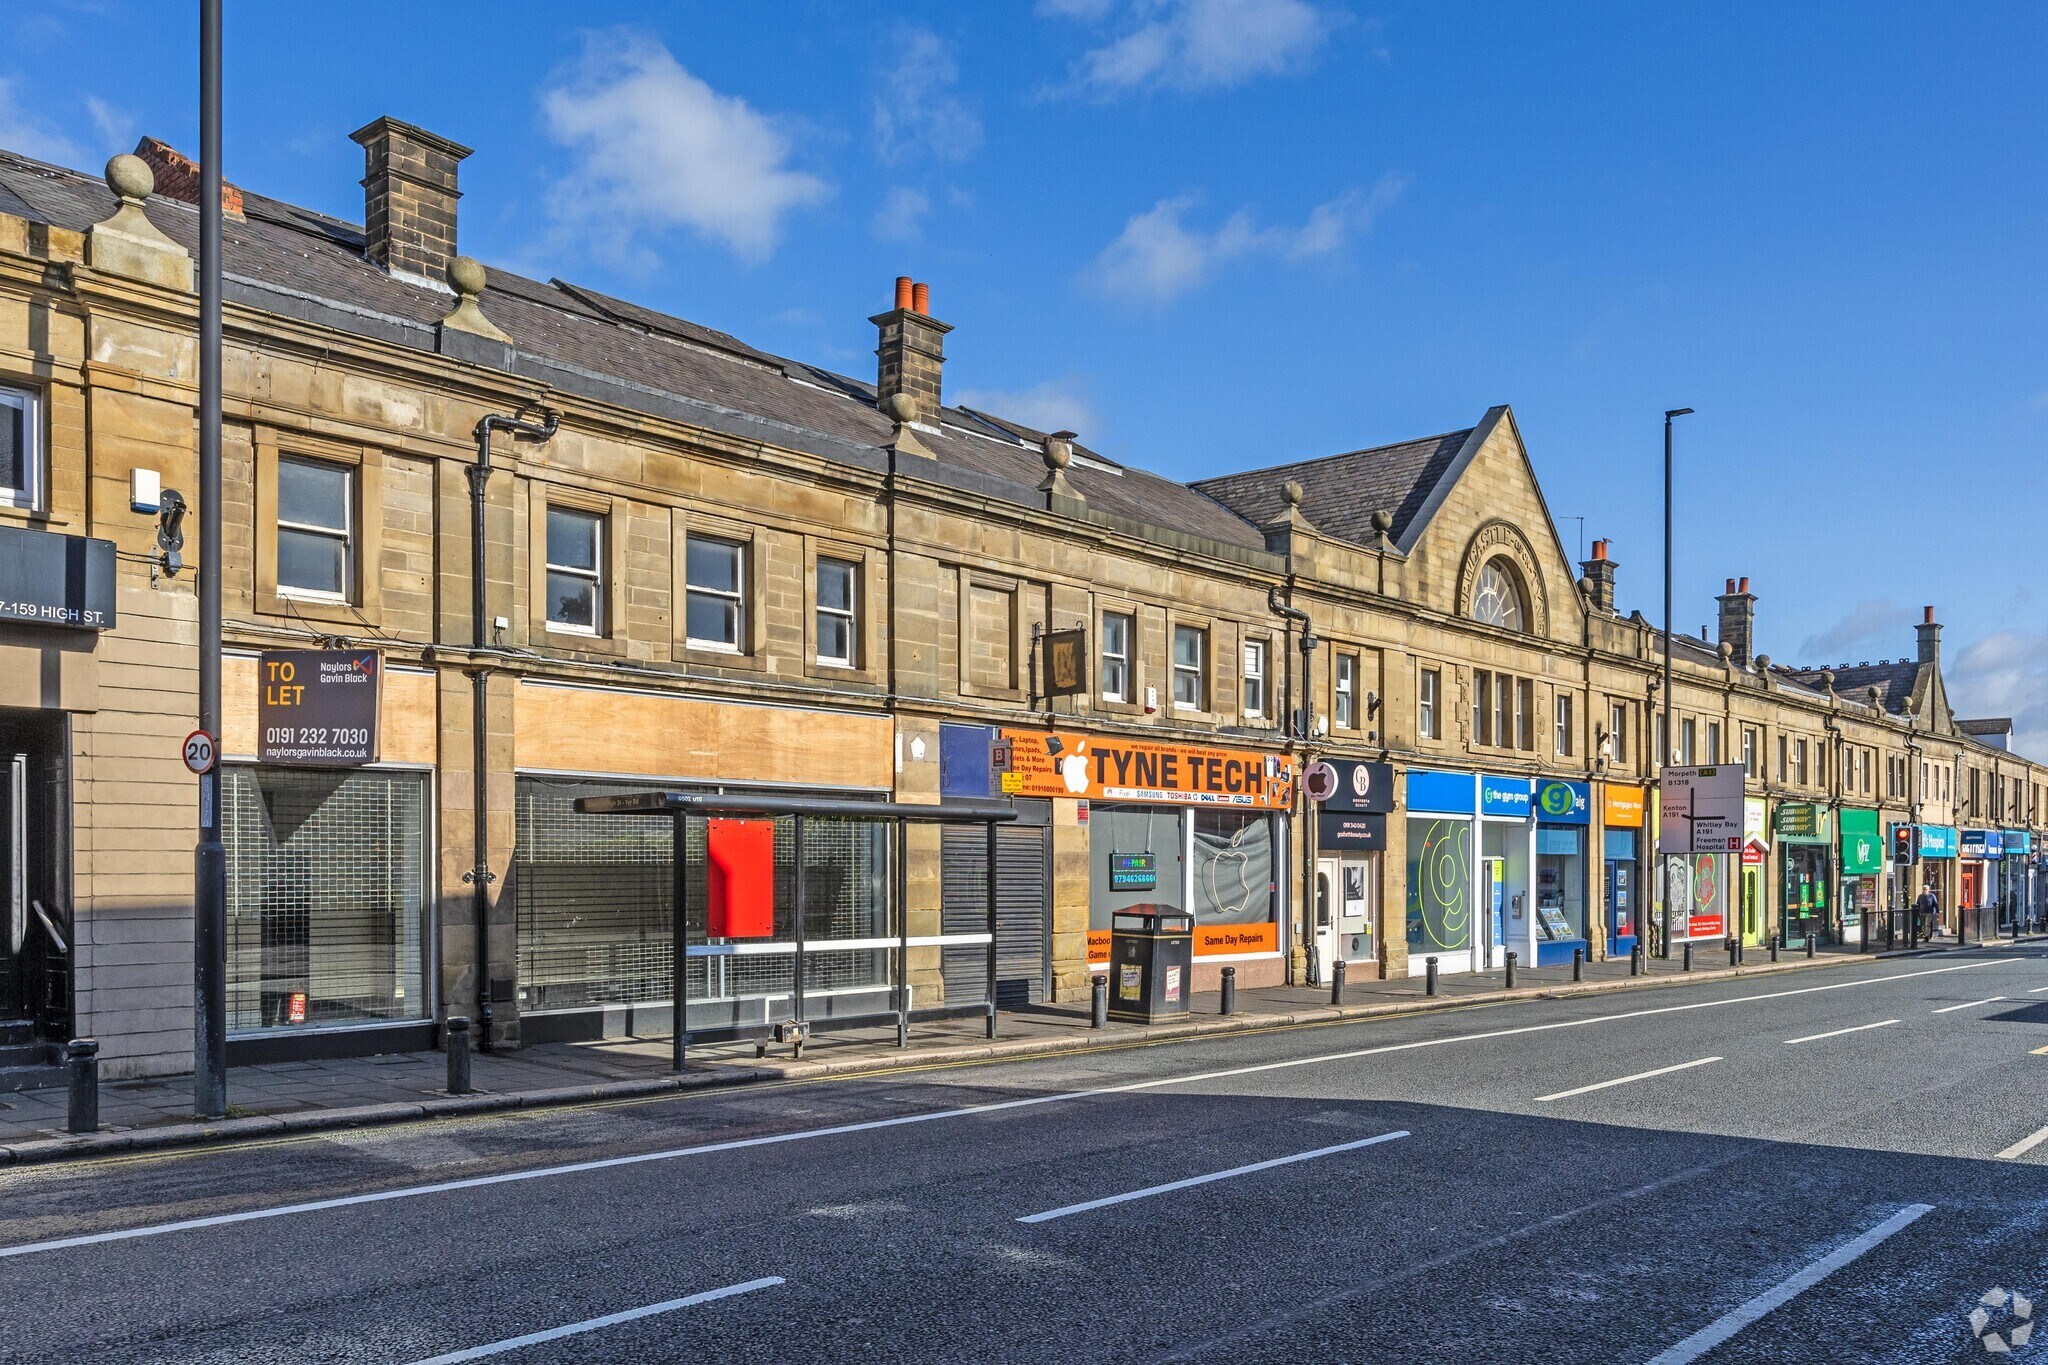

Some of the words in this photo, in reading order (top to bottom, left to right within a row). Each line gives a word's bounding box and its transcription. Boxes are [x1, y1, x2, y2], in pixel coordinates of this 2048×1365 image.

[41, 605, 79, 620] HIGH
[83, 611, 104, 624] ST.
[267, 661, 295, 682] TO
[320, 662, 352, 673] Naylors
[320, 673, 343, 683] Gavin
[344, 673, 367, 683] Black
[267, 685, 305, 706] LET
[266, 727, 295, 744] 0191
[299, 727, 327, 744] 232
[332, 728, 368, 745] 7030
[188, 742, 211, 761] 20
[266, 746, 367, 758] naylorsgavinblack.co.uk
[995, 750, 1004, 761] B
[1021, 764, 1031, 773] Day
[1032, 765, 1052, 773] Repairs
[1091, 748, 1178, 788] TYNE
[1187, 756, 1262, 793] TECH
[1668, 769, 1697, 778] Morpeth
[1699, 768, 1716, 776] (A1)
[1136, 790, 1163, 799] SAMSUNG
[1167, 792, 1192, 800] TOSHIBA
[1232, 795, 1253, 804] ASUS
[1493, 790, 1501, 799] the
[1502, 792, 1514, 803] gym
[1514, 793, 1529, 804] group
[1780, 808, 1811, 816] SUBWAY
[1780, 816, 1811, 824] SUBWAY
[1780, 824, 1811, 832] SUBWAY
[1729, 838, 1739, 848] H
[1928, 834, 1945, 853] Hospice
[1122, 858, 1146, 867] REPAIR
[1087, 937, 1111, 946] Macboo
[1204, 935, 1224, 946] Same
[1225, 934, 1238, 946] Day
[1239, 933, 1264, 945] Repairs
[1088, 951, 1107, 959] Game
